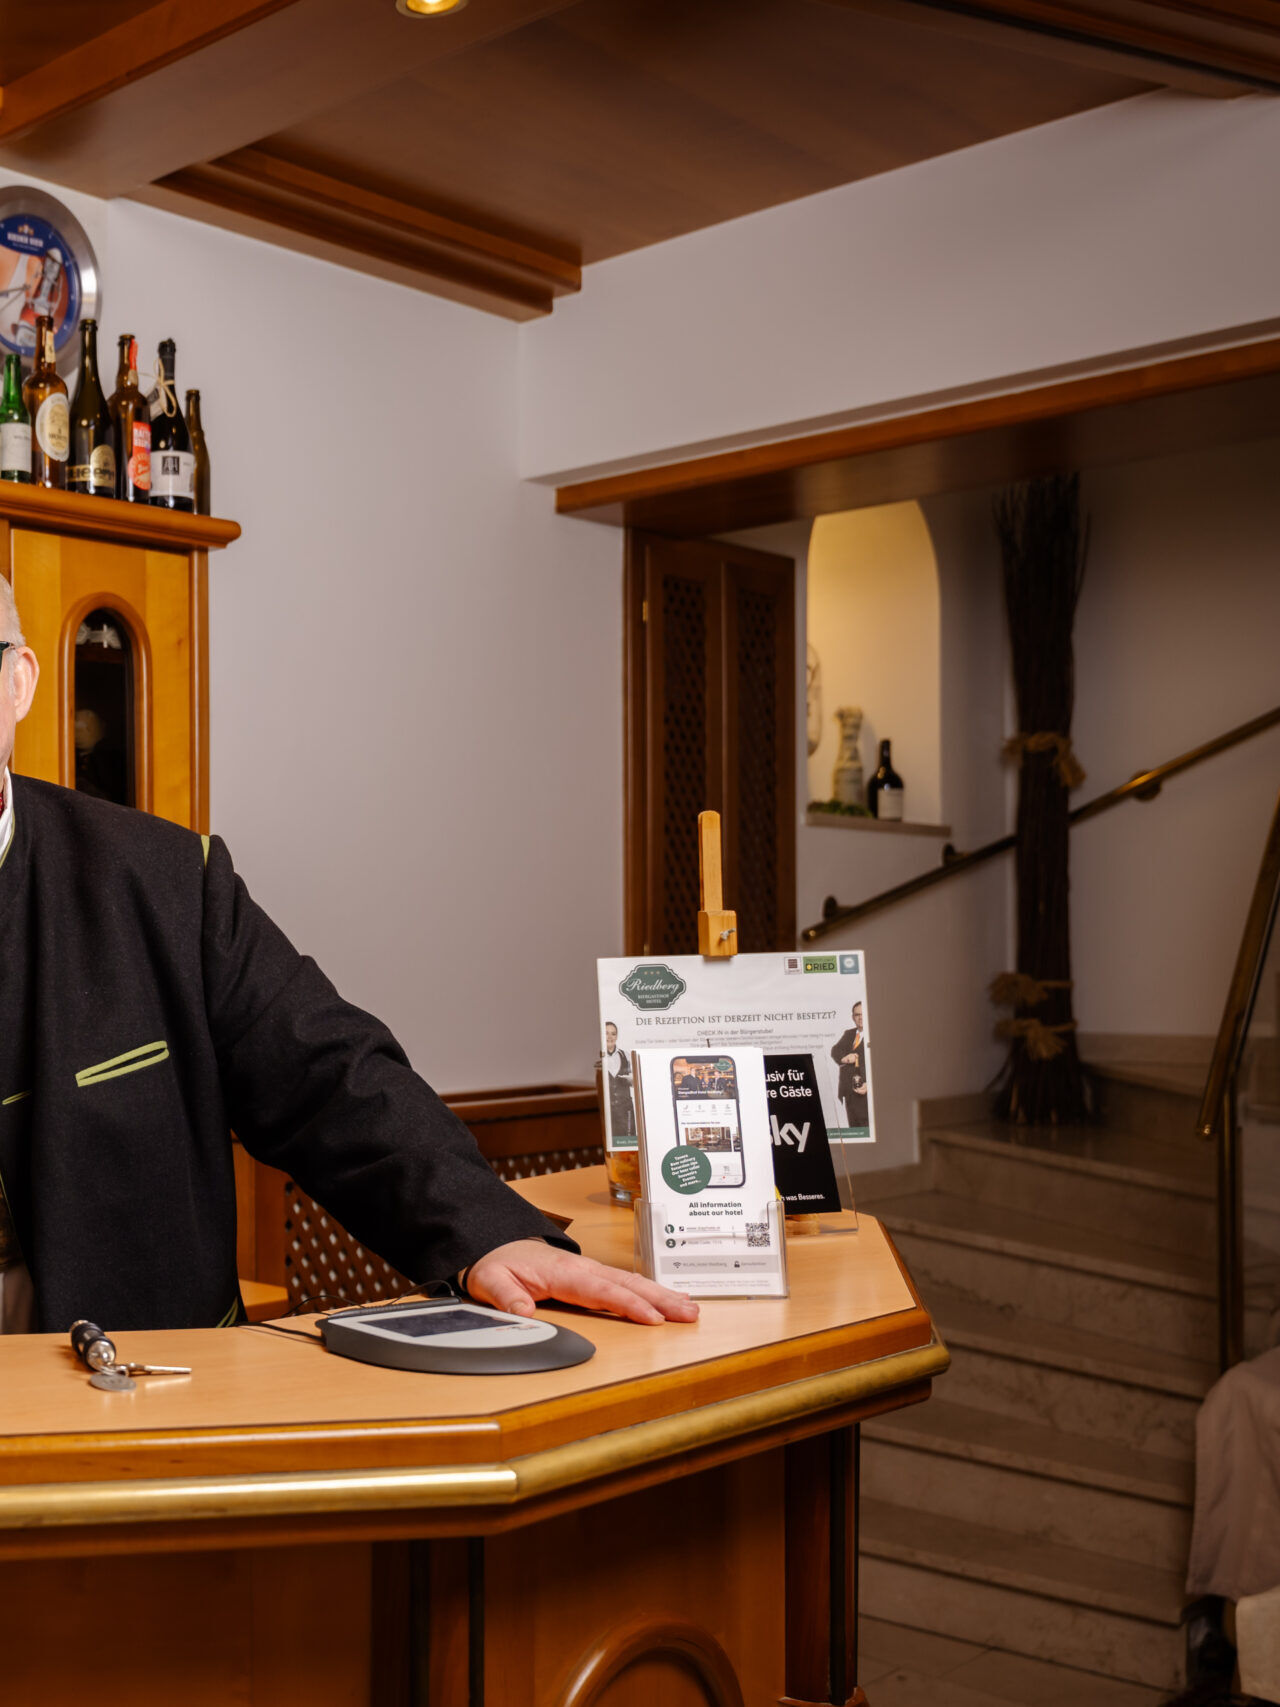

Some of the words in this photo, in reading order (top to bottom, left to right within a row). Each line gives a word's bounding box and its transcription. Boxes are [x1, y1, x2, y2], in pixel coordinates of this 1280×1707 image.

[626, 978, 680, 994] Riedberg
[635, 1017, 652, 1026] DIE
[655, 1016, 705, 1025] REZEPTION
[708, 1015, 721, 1023] IST
[724, 1014, 761, 1023] DERZEIT
[764, 1013, 794, 1021] NICHT
[797, 1010, 837, 1020] BESETZT?
[787, 1069, 805, 1081] für
[779, 1086, 813, 1098] Gäste
[770, 1114, 811, 1153] ky
[798, 1193, 825, 1201] Besseres.
